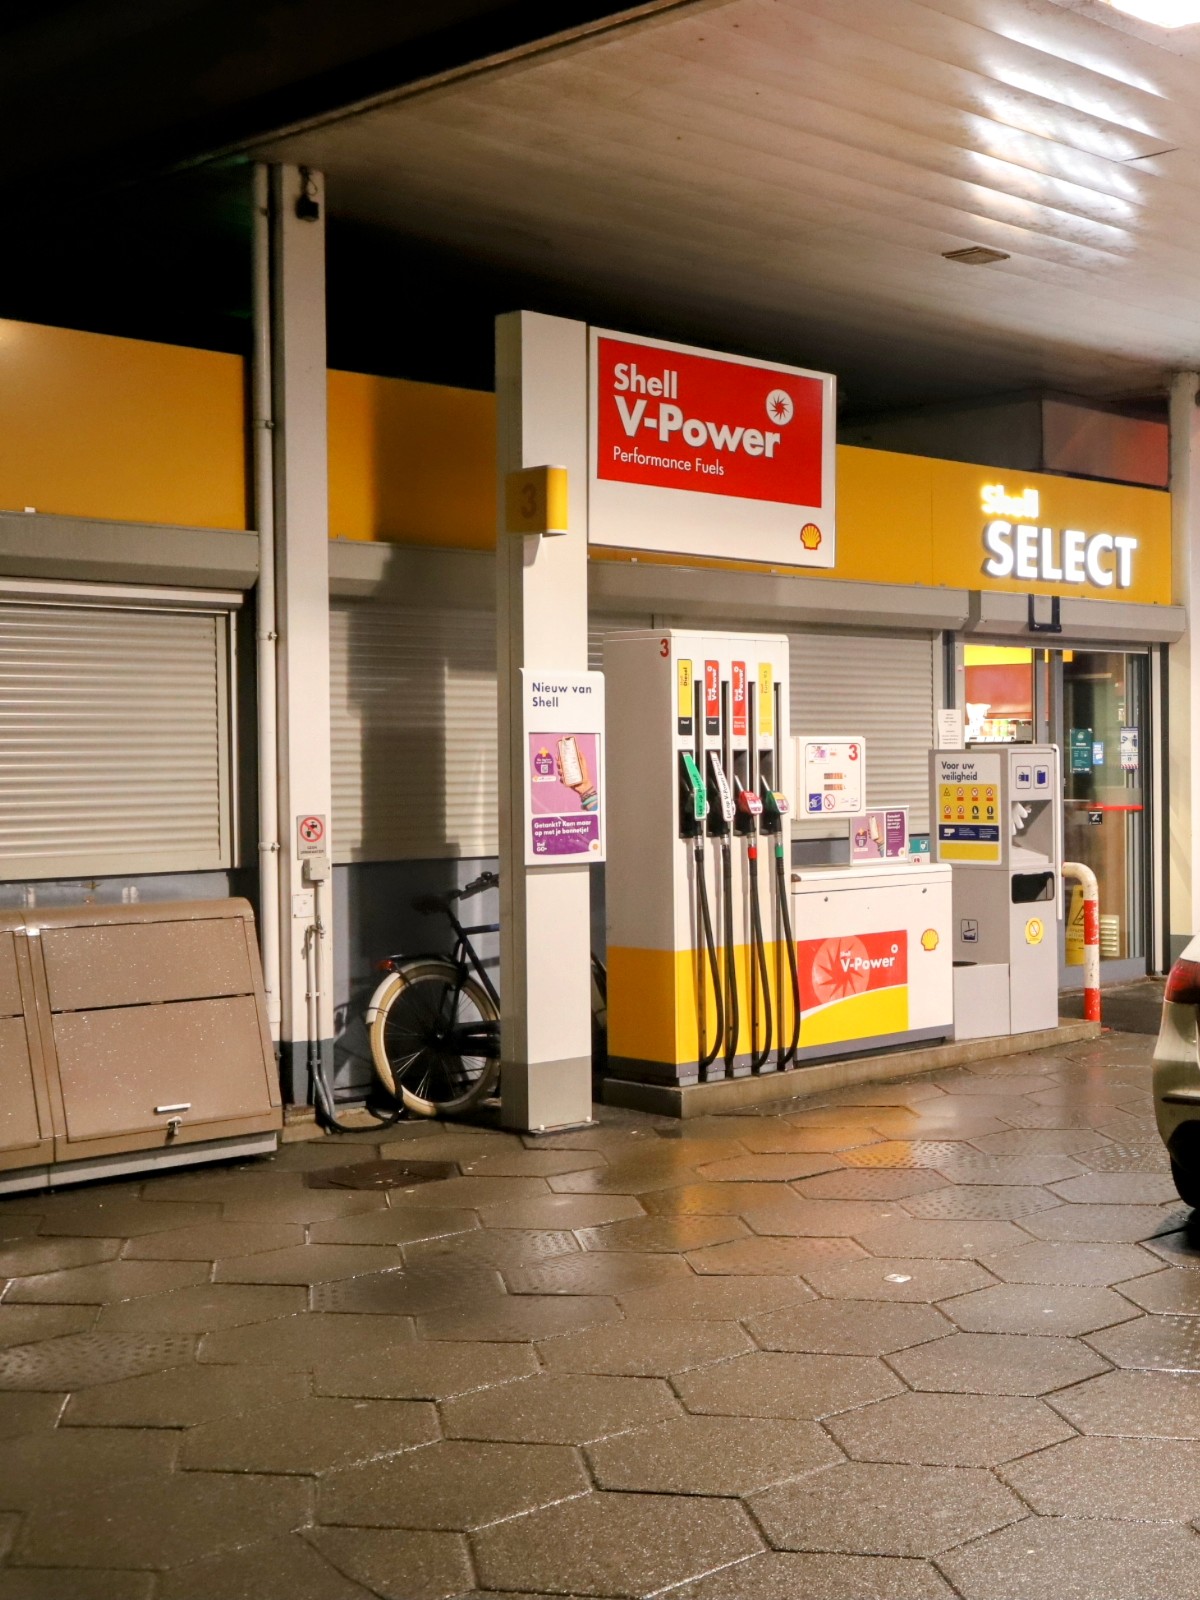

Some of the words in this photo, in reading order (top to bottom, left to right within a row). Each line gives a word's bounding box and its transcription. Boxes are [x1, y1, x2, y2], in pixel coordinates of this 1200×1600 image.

[613, 363, 678, 399] Shell
[613, 394, 782, 459] V-Power
[613, 446, 692, 472] Performance
[695, 458, 725, 477] Fuels
[521, 482, 537, 519] 3
[981, 484, 1039, 519] Shell
[984, 520, 1138, 588] SELECT
[660, 638, 669, 658] 3
[532, 682, 568, 693] Nieuw
[572, 686, 592, 694] van
[532, 696, 559, 707] Shell
[848, 744, 858, 761] 3
[941, 761, 959, 770] Voor
[941, 771, 978, 782] veiligheid
[534, 821, 561, 829] Getankt?
[534, 830, 543, 838] op
[841, 957, 896, 973] V-Power
